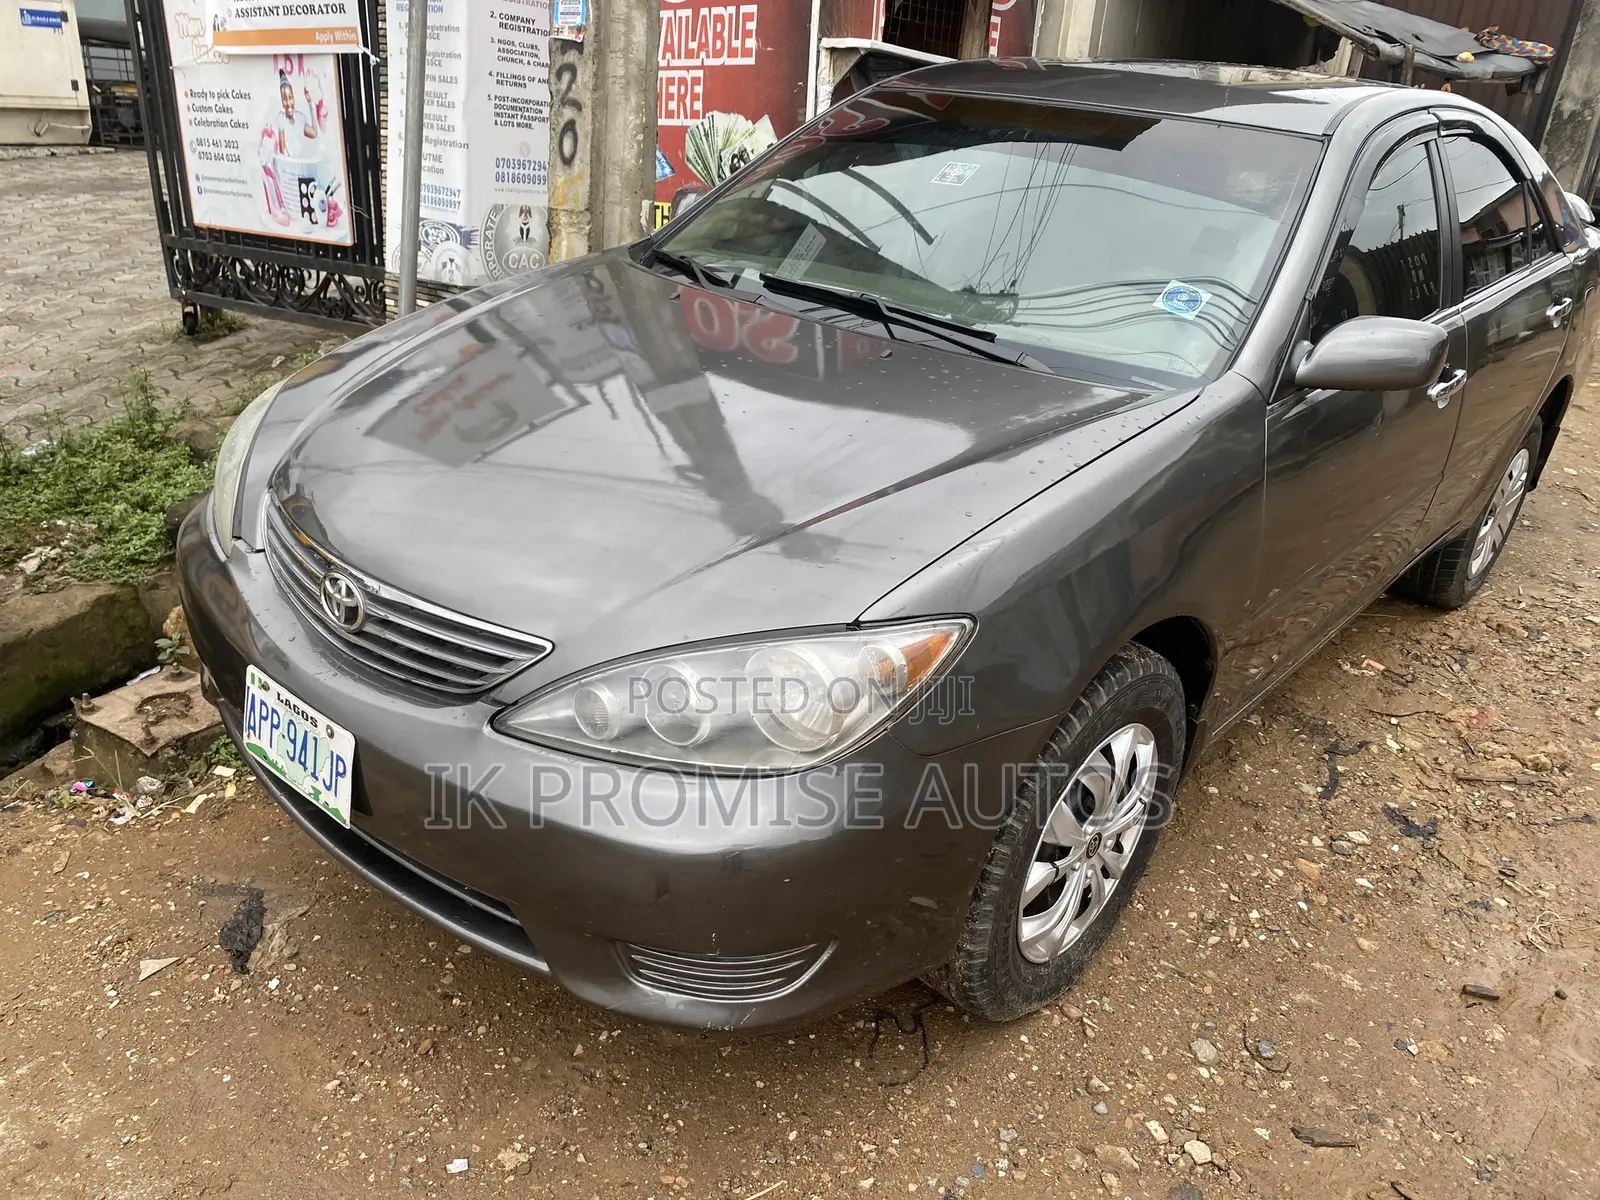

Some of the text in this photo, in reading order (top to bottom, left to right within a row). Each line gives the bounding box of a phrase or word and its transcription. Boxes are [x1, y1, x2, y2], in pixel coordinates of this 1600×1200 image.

[235, 3, 346, 18] ASSISTANT DECORATOR
[490, 11, 536, 25] 2. COMPANY
[427, 23, 460, 32] egistration
[499, 22, 550, 36] REGISTRATIO
[316, 30, 357, 43] Apply Within
[658, 4, 757, 66] AILABLE
[518, 42, 540, 51] CLUBS,
[426, 74, 436, 82] PIN
[437, 75, 458, 84] SALES
[496, 72, 526, 81] FILLINGS
[527, 75, 536, 83] OF
[496, 79, 527, 88] RETURNS
[190, 89, 251, 101] Ready to pick Cakes
[425, 90, 448, 99] RESULT
[436, 100, 456, 109] SALES
[494, 95, 549, 107] POST-INCORPORATI
[192, 103, 233, 114] Custom Cakes
[494, 103, 543, 115] DOCUMENTATION
[424, 113, 448, 122] RESULT
[494, 111, 549, 123] INSTANT PASSPORT
[193, 118, 249, 129] Celebration Cakes
[435, 123, 456, 132] SALES
[500, 120, 515, 128] LOTS
[516, 122, 534, 130] MORE.
[424, 135, 469, 149] Registration
[495, 157, 550, 172] 0703967294
[495, 171, 548, 185] 0818609099
[508, 253, 540, 270] CAC
[276, 691, 319, 728] LAGOS
